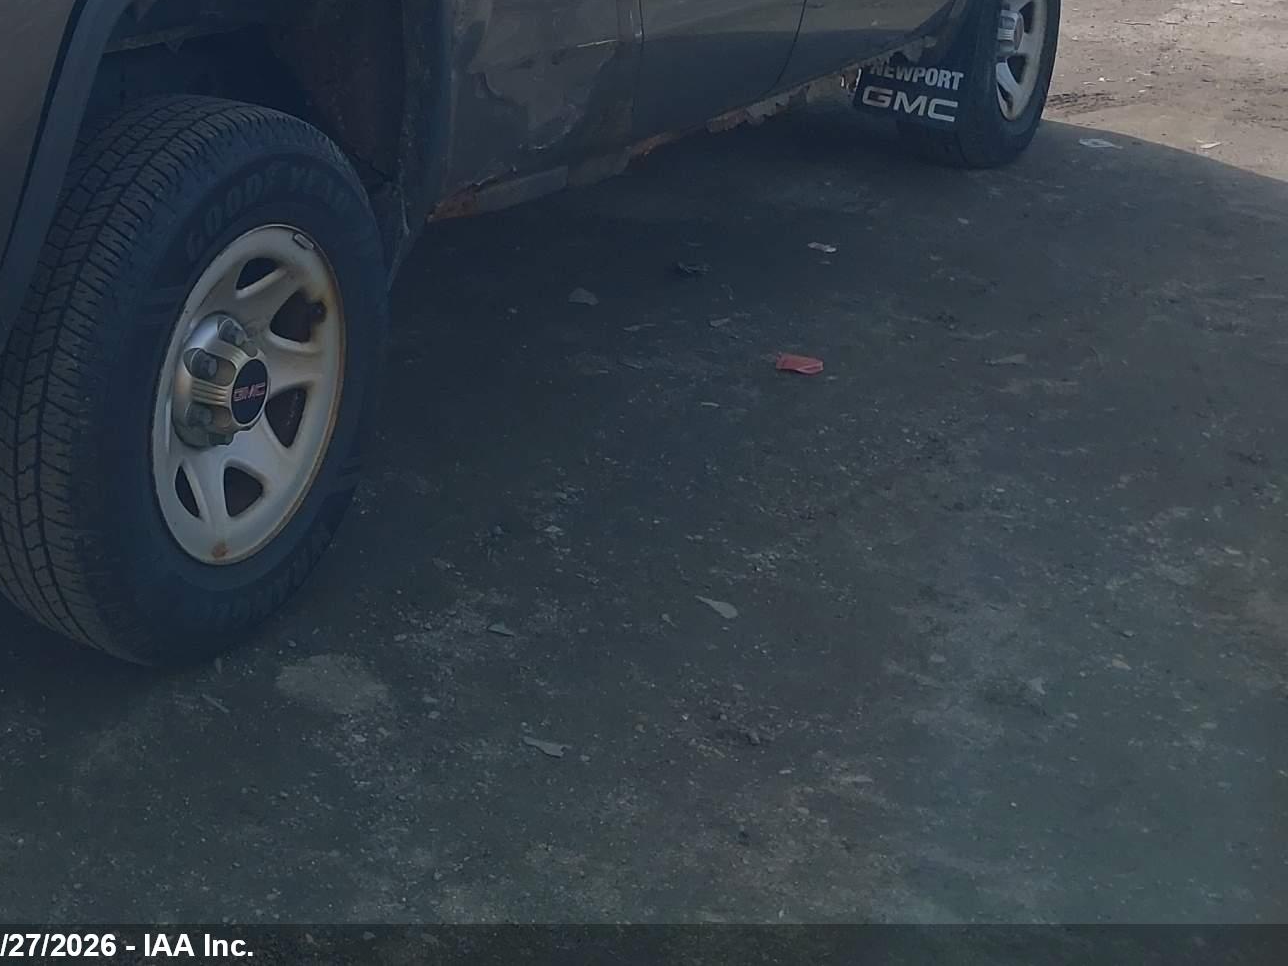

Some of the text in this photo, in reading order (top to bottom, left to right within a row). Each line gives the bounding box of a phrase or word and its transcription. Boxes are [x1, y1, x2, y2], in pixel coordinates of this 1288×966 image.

[870, 64, 964, 90] NEWPORT
[862, 85, 958, 122] GMC
[233, 382, 265, 402] GMC
